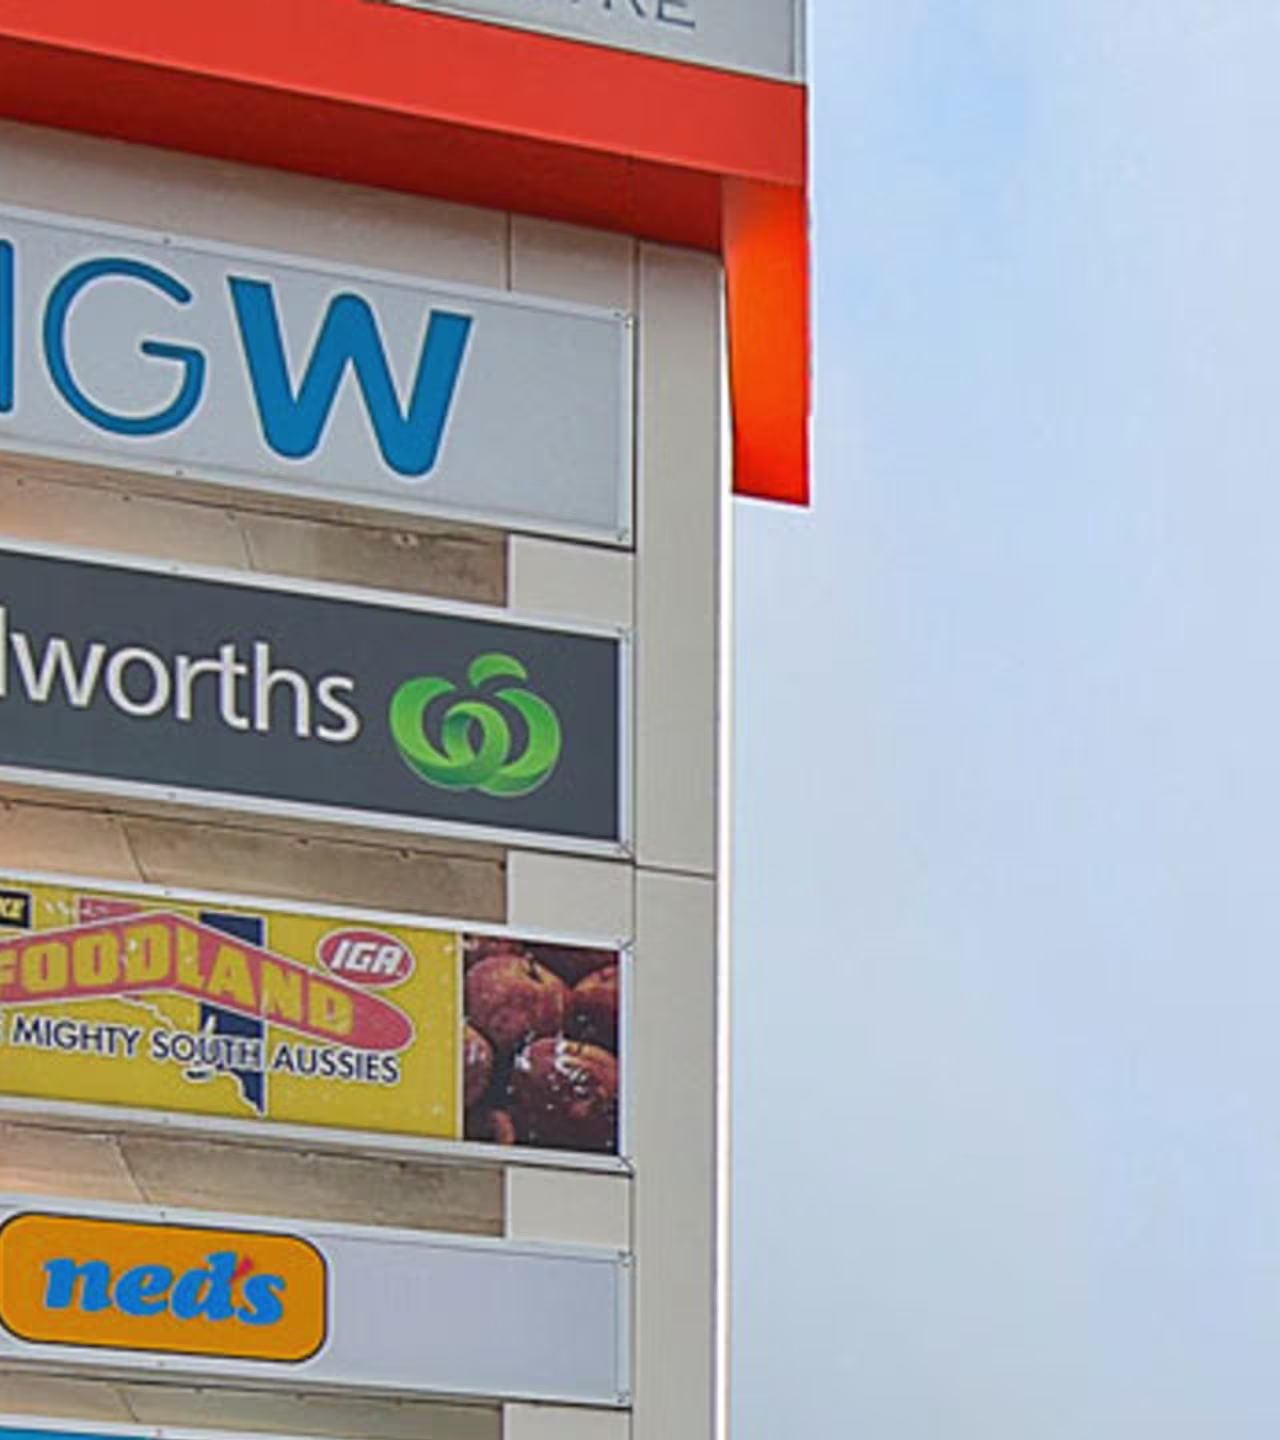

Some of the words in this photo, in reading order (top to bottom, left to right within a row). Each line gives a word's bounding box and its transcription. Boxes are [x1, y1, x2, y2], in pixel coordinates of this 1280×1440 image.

[330, 939, 404, 976] IGA
[13, 1017, 141, 1056] MIGHTY
[152, 1033, 262, 1068] SOUTH
[273, 1045, 399, 1083] AUSSIES
